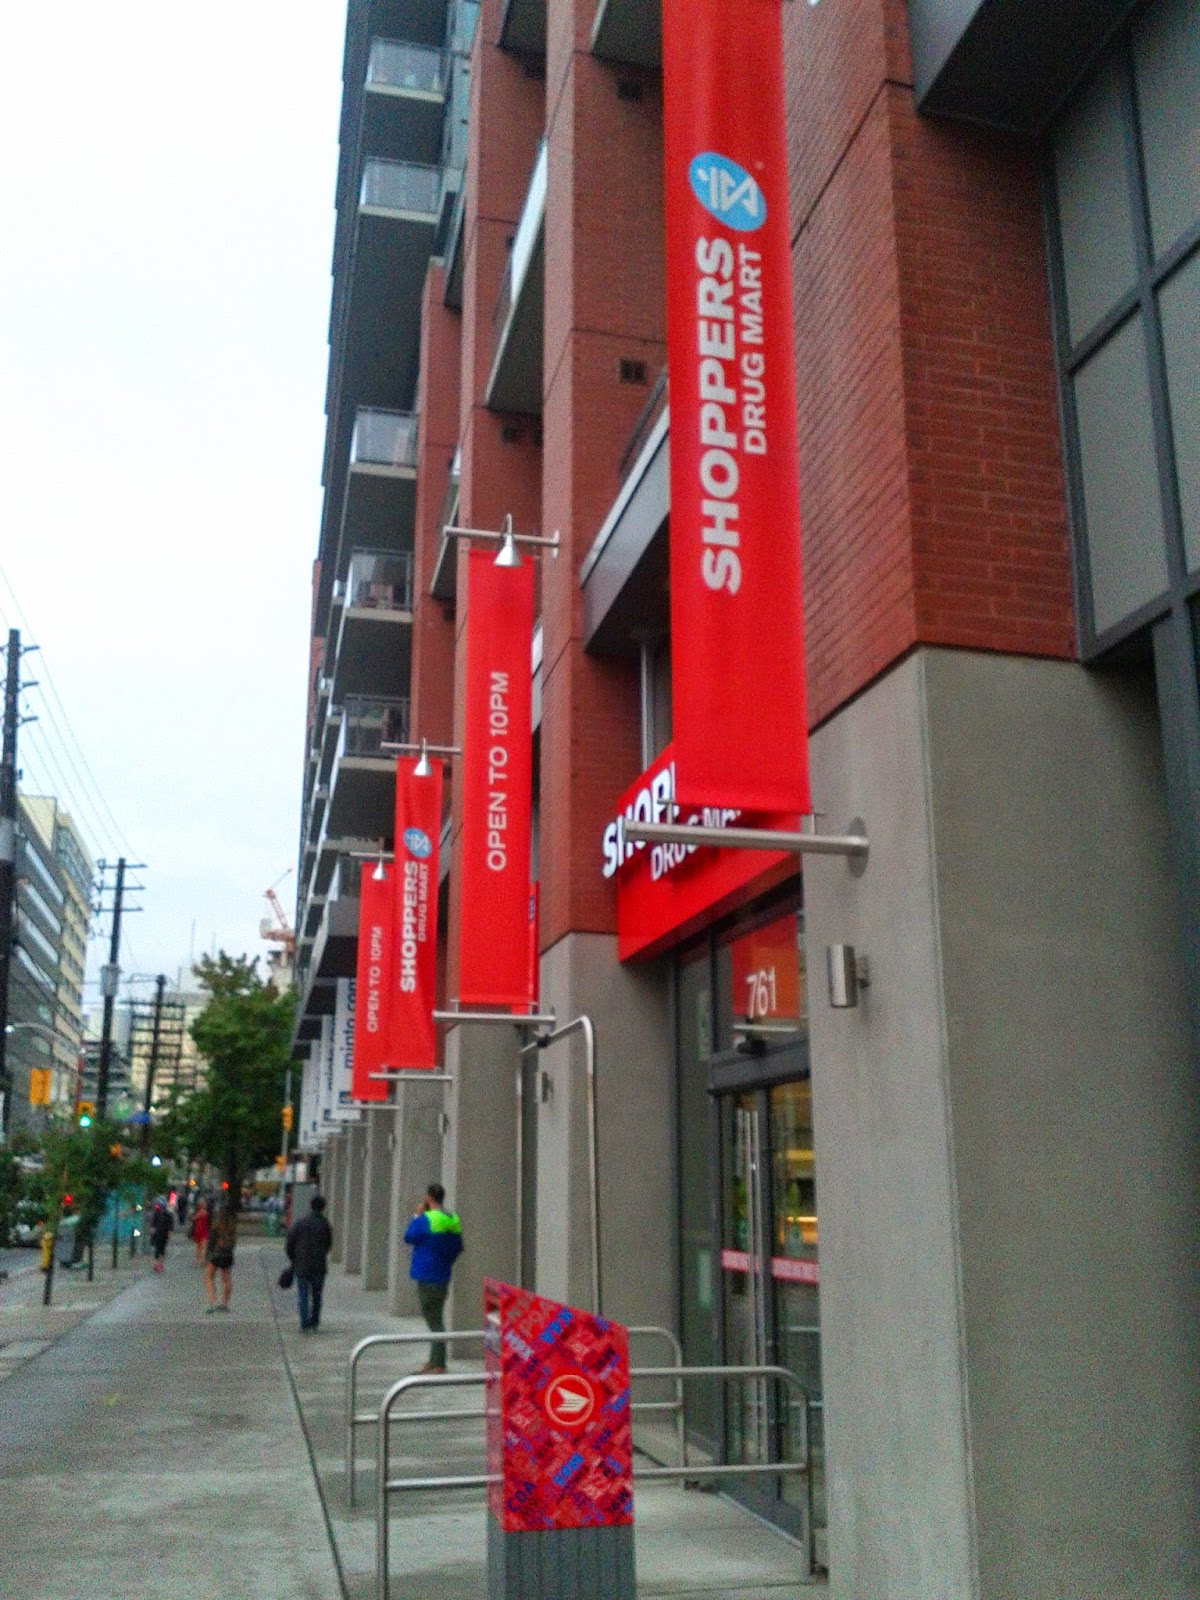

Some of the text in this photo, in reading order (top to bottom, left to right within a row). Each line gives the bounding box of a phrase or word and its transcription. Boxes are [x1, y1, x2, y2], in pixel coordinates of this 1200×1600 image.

[695, 236, 742, 594] SHOPPERS
[738, 243, 768, 455] DRUG MART
[487, 671, 509, 872] OPEN TO 10PM
[399, 860, 418, 993] SHOPPERS
[417, 862, 428, 942] DRUG MART
[367, 925, 382, 1033] OPEN TO 10PM
[747, 966, 776, 1018] 761
